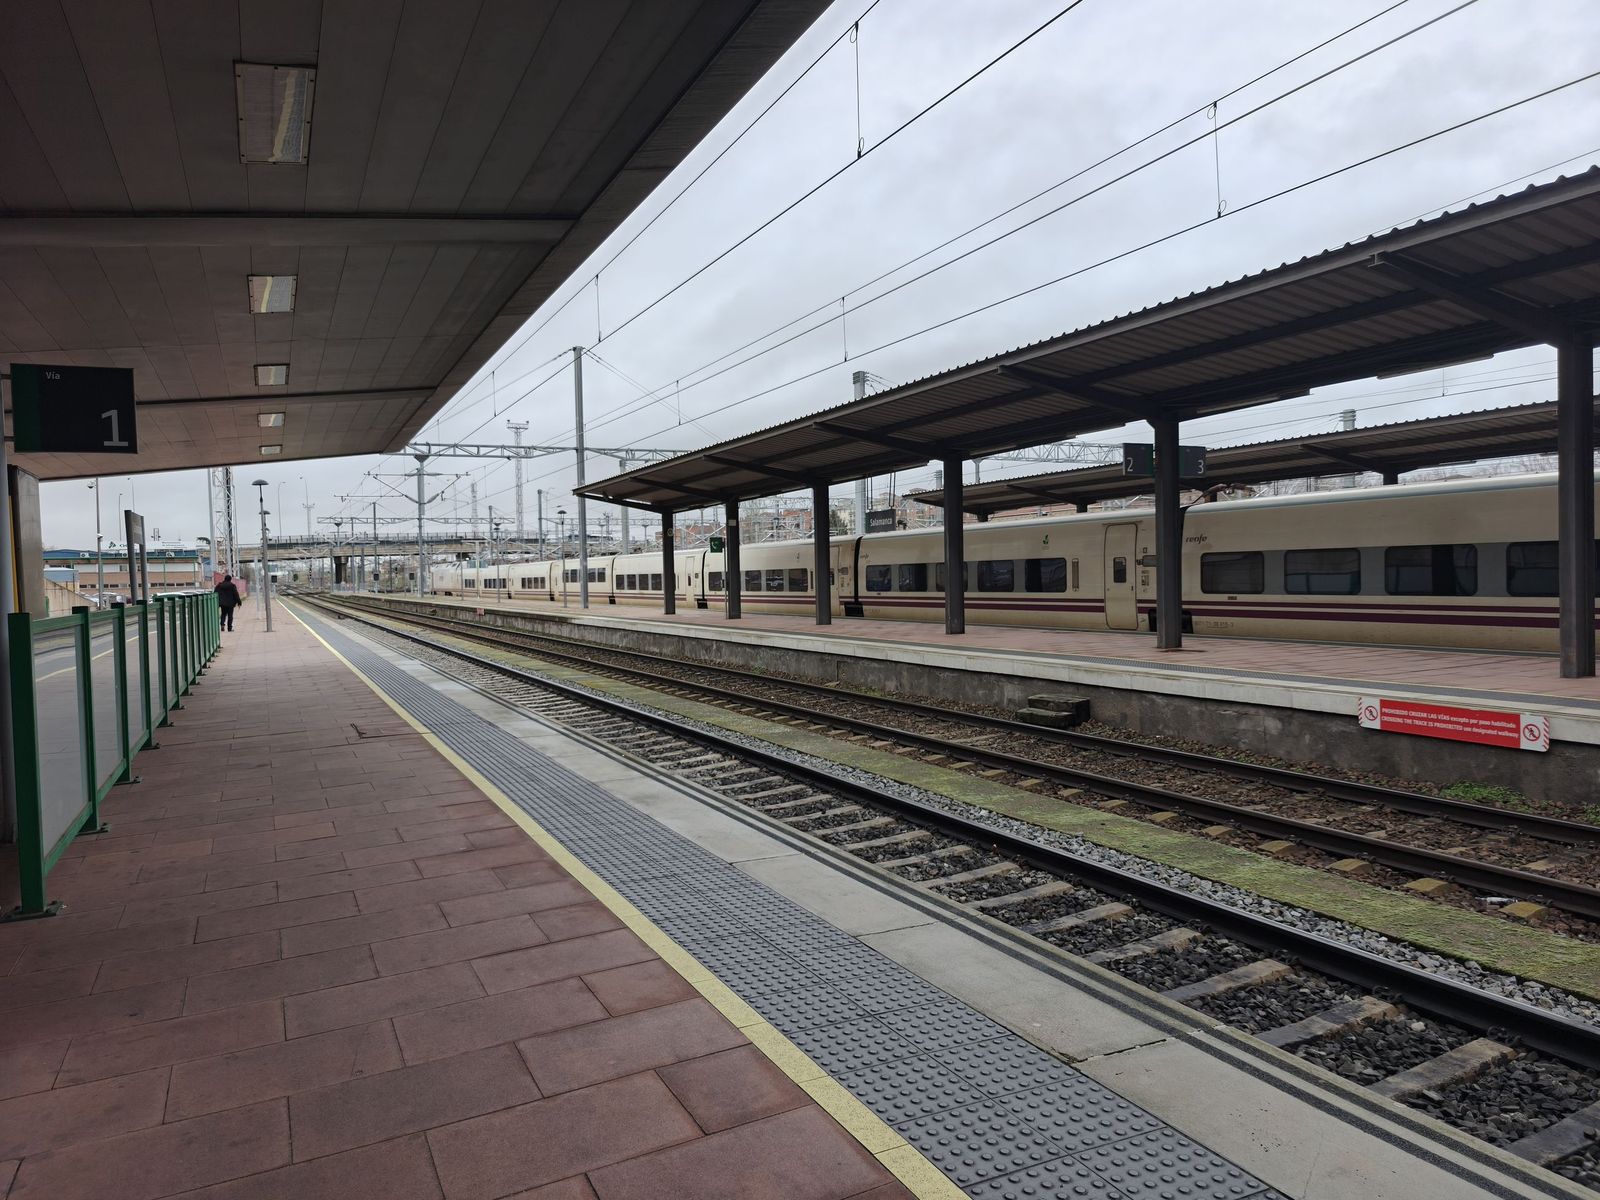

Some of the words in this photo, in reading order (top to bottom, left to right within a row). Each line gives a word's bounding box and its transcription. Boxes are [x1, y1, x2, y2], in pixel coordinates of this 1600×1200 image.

[101, 409, 129, 447] 1
[1126, 457, 1134, 472] 2
[1197, 459, 1204, 474] 3
[870, 517, 893, 527] Salamanca
[1185, 534, 1207, 544] renfe
[1409, 710, 1427, 718] CRUZAR
